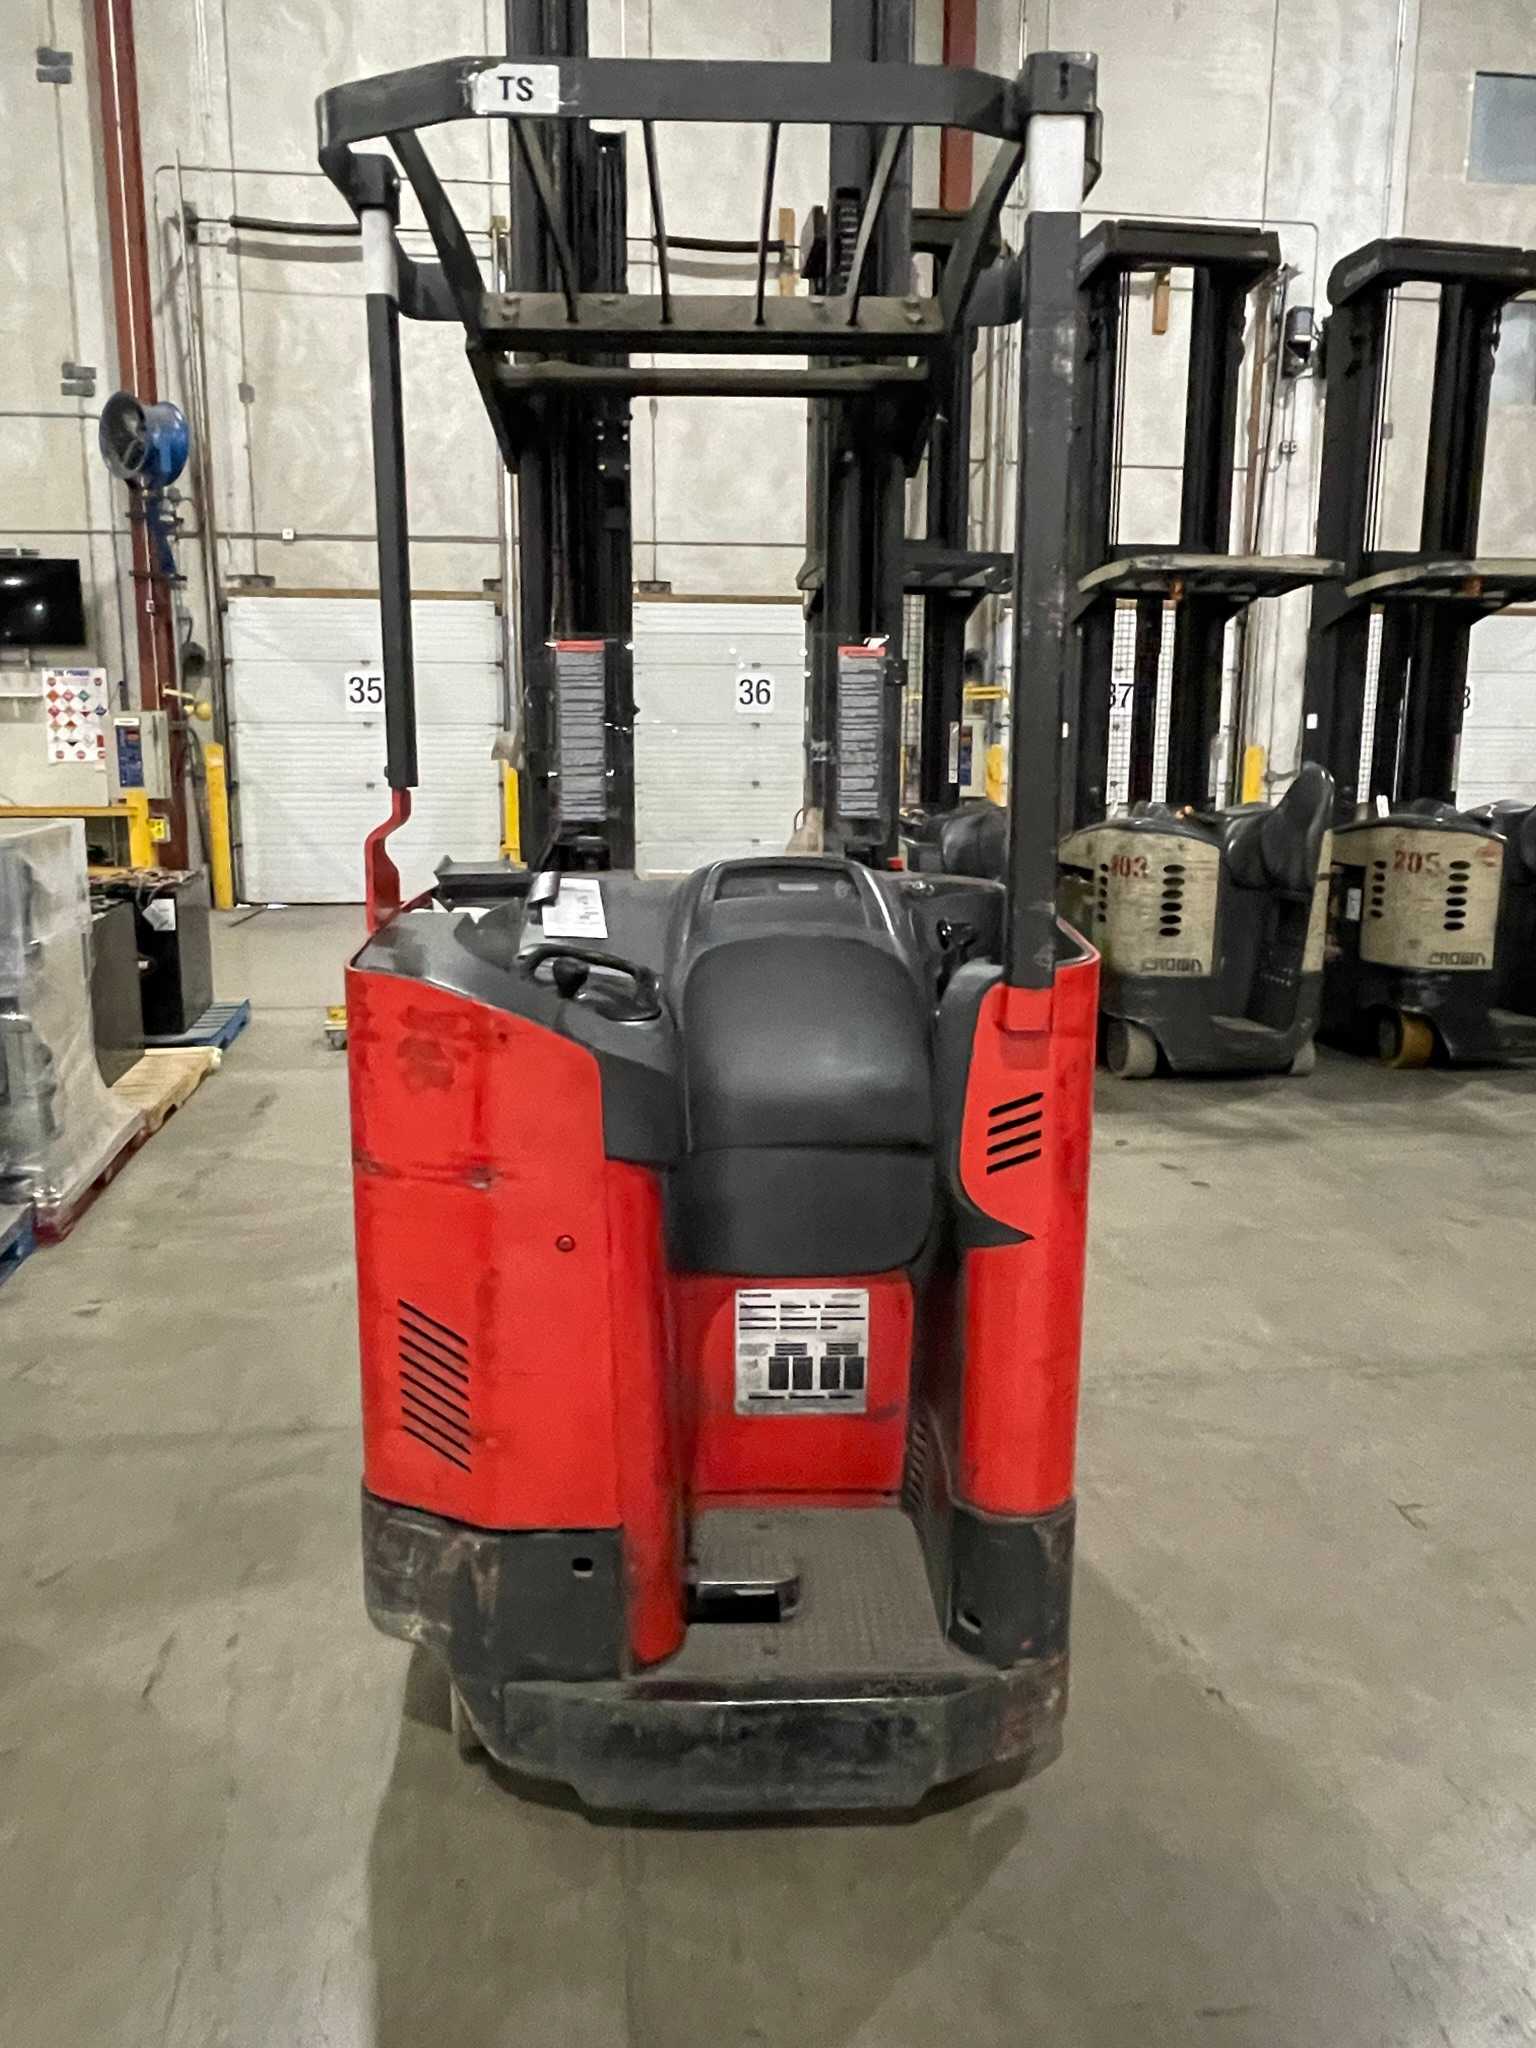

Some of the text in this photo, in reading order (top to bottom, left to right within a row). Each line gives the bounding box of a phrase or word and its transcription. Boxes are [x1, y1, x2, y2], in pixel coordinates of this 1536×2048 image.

[497, 76, 533, 102] TS
[349, 676, 382, 704] 35
[739, 679, 771, 705] 36
